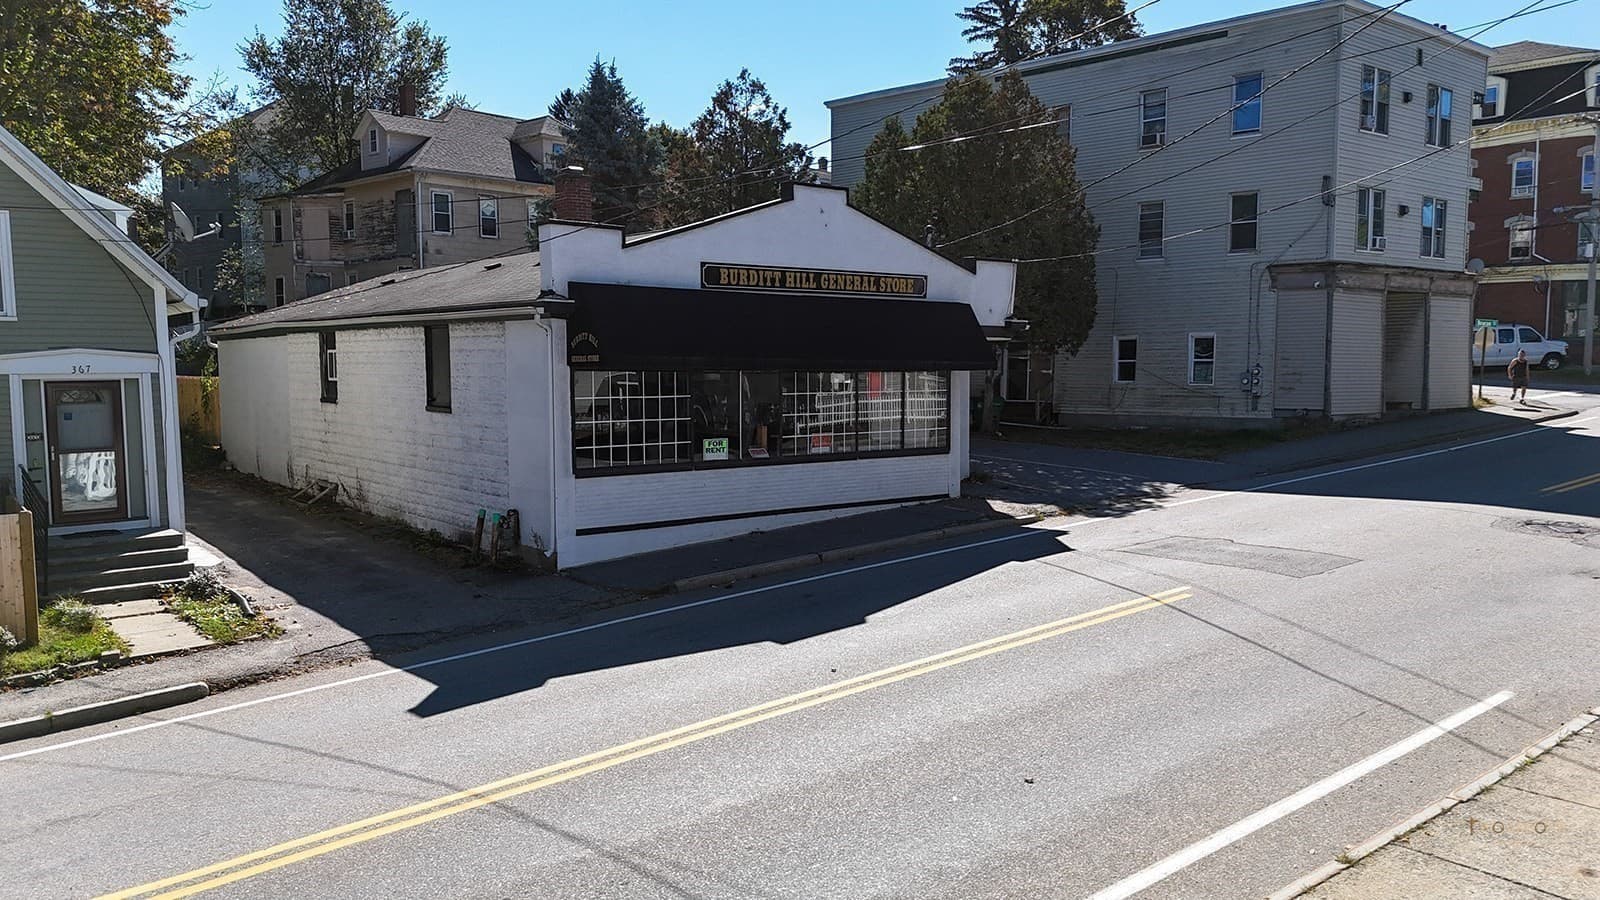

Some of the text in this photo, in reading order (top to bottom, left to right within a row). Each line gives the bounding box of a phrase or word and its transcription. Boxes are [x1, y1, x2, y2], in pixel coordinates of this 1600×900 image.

[720, 268, 914, 293] BURDITT HILL GENERAL STORE
[72, 365, 90, 374] 367
